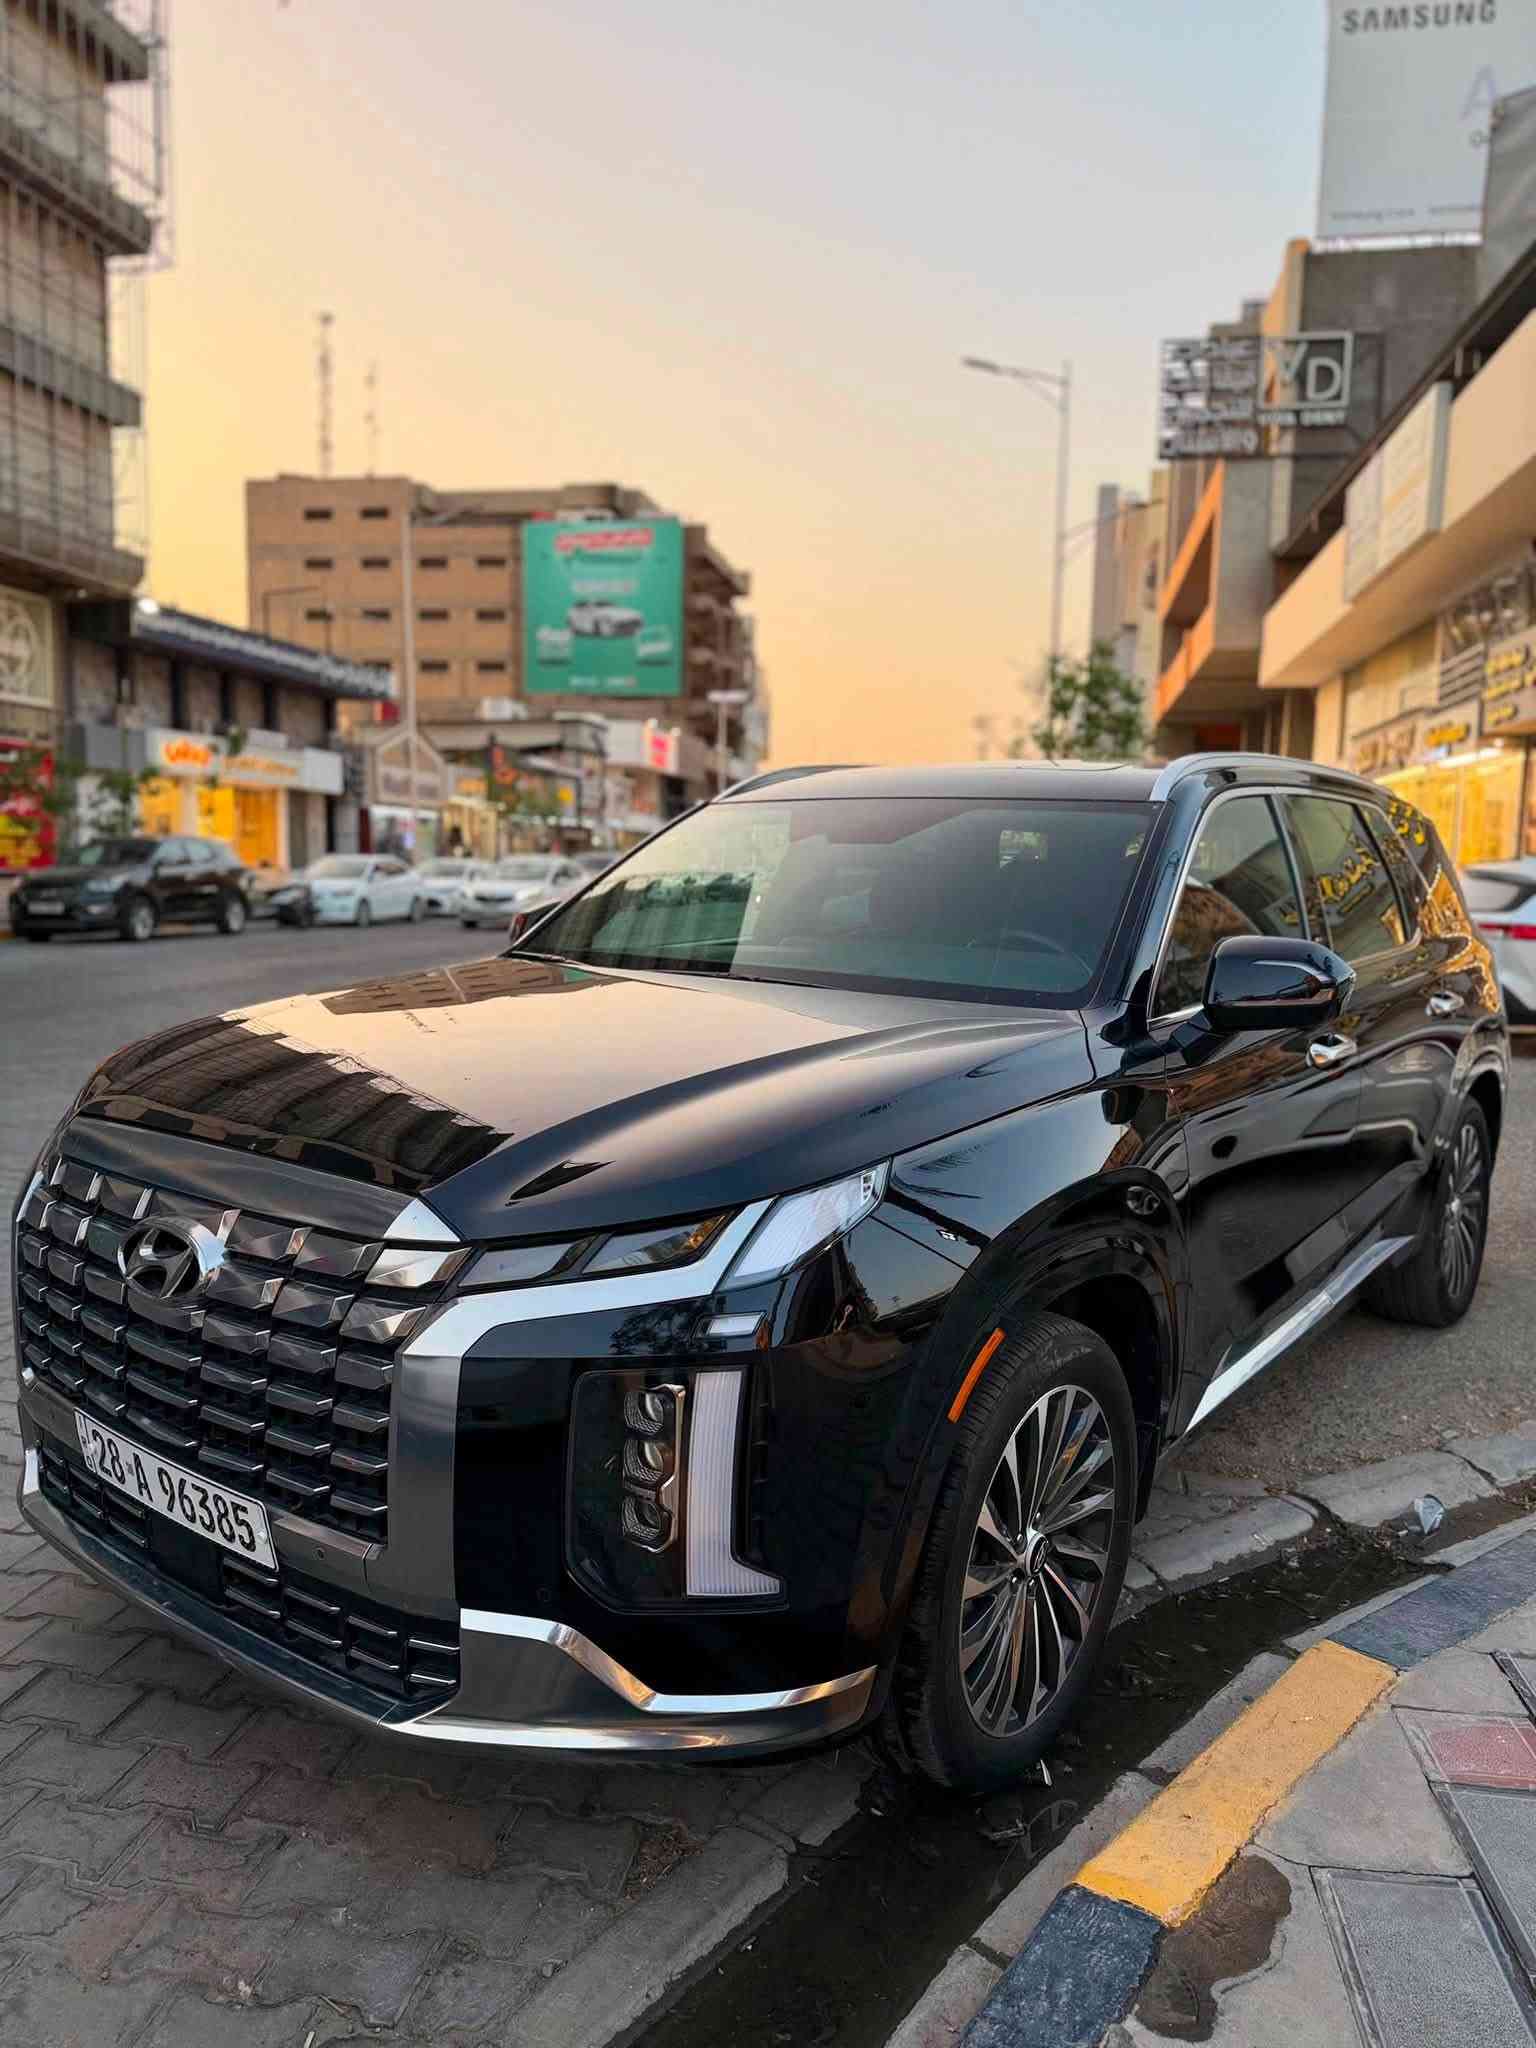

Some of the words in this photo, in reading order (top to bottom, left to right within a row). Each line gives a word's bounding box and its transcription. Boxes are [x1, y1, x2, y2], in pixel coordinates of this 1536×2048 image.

[1342, 0, 1497, 36] SAMSUNG
[92, 1429, 125, 1485] 28
[133, 1452, 153, 1502] A
[157, 1467, 256, 1552] 96385
